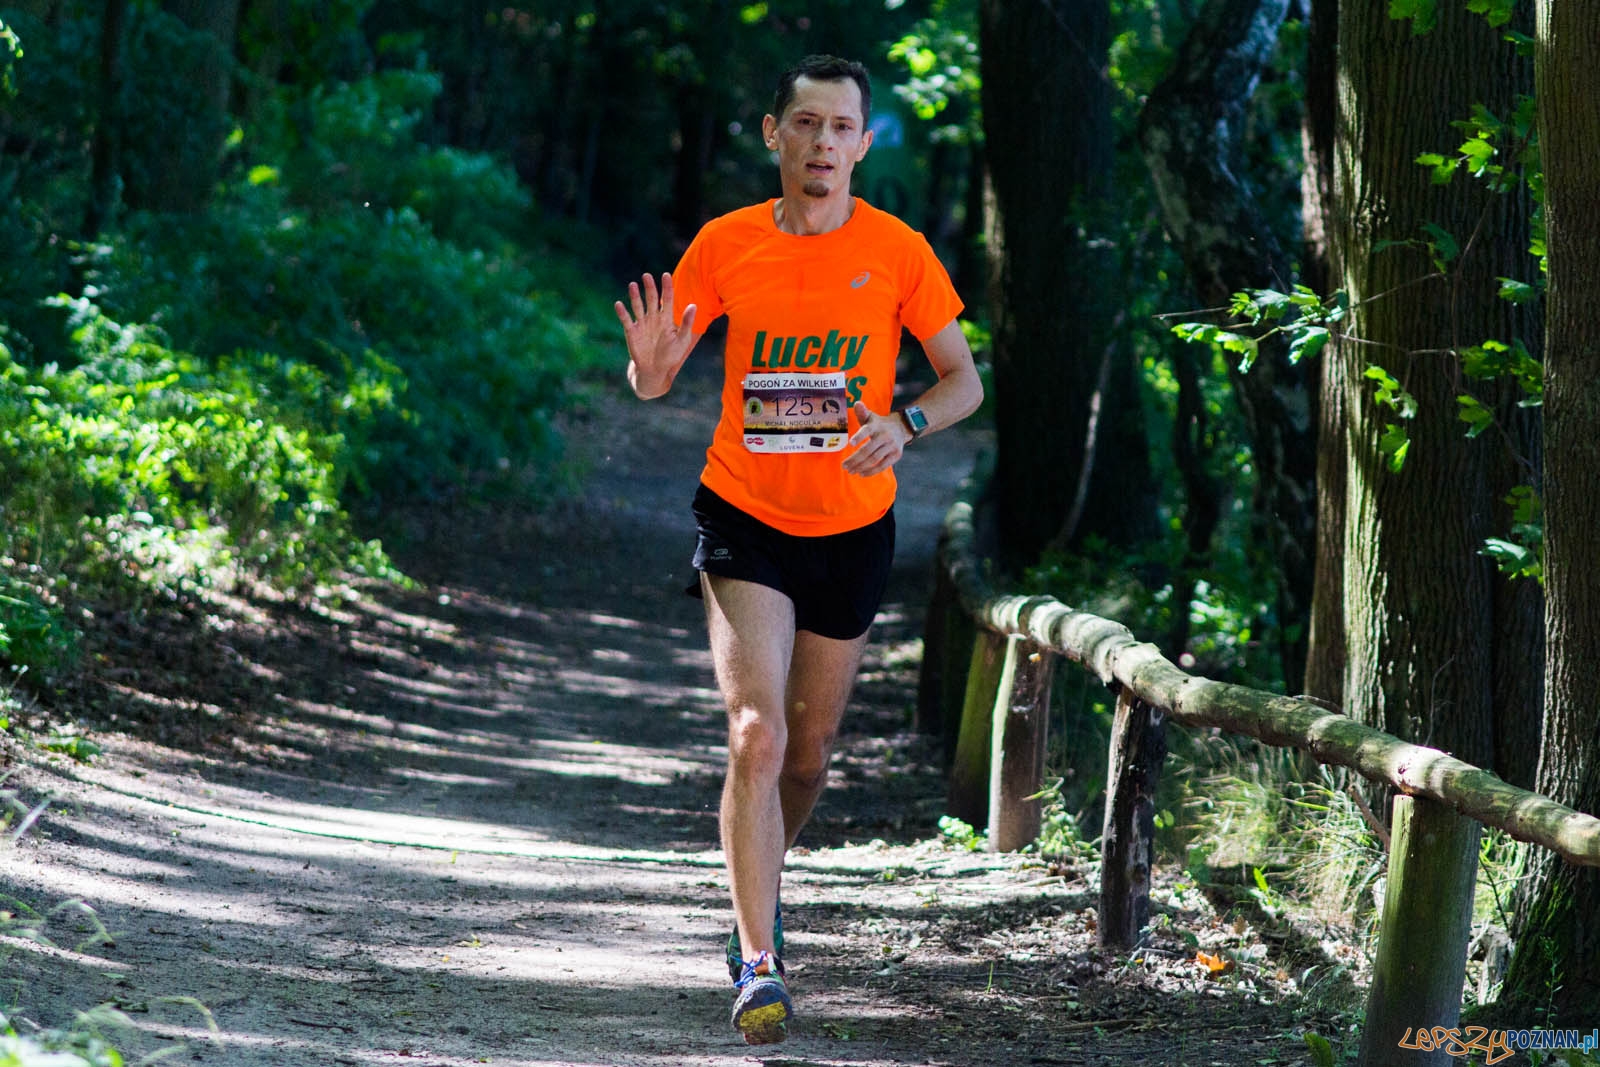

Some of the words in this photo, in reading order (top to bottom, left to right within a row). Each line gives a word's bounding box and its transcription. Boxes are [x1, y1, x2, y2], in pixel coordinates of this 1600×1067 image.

[751, 329, 870, 371] Lucky
[748, 378, 781, 388] POGOŃ
[783, 378, 796, 388] ZA
[797, 378, 838, 388] WILKIEM
[771, 395, 814, 417] 125
